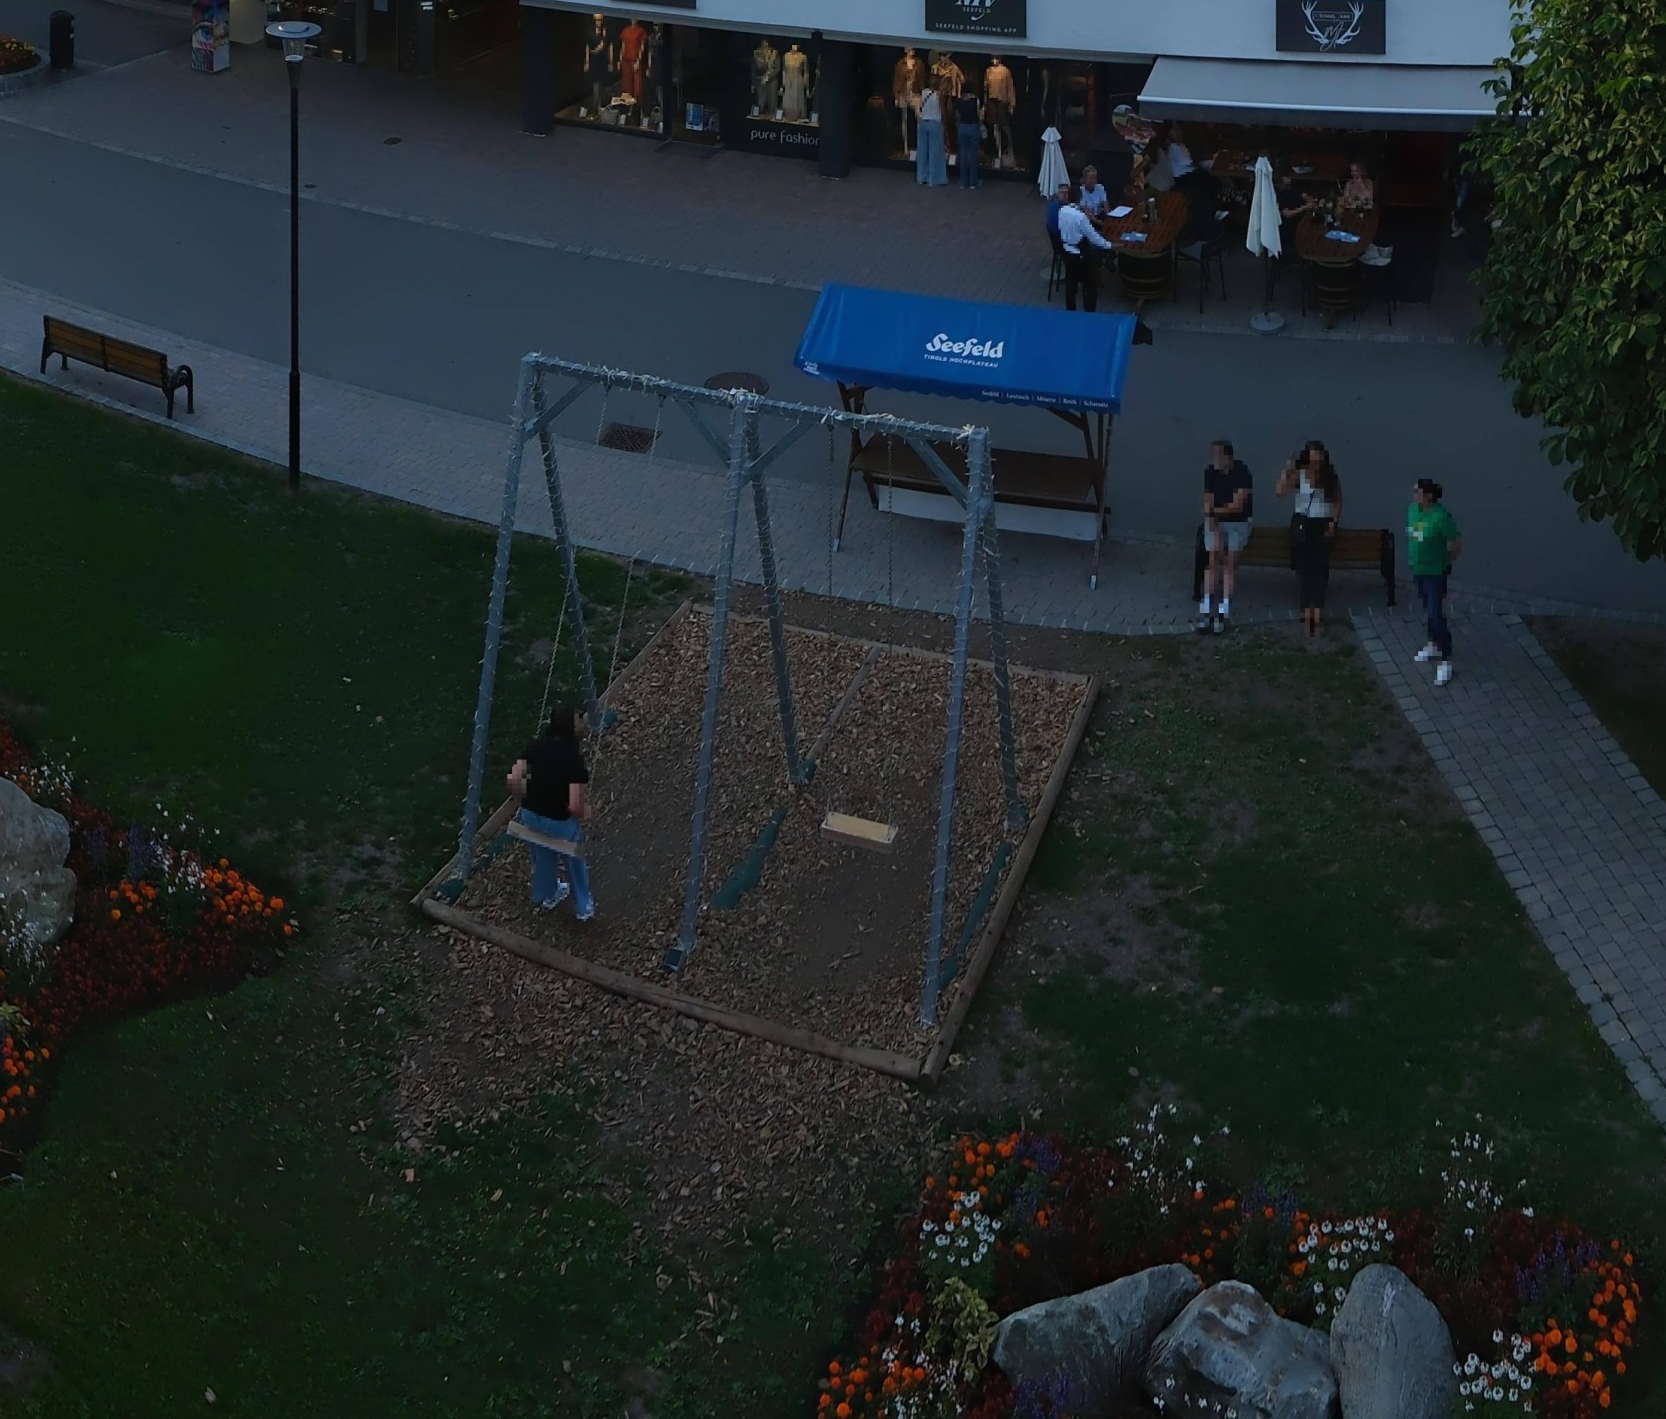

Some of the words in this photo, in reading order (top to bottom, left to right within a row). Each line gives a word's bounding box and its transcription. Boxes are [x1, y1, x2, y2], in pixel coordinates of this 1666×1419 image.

[967, 25, 1001, 33] SHOPPING
[751, 129, 776, 141] pure
[925, 333, 1004, 359] Seefeld
